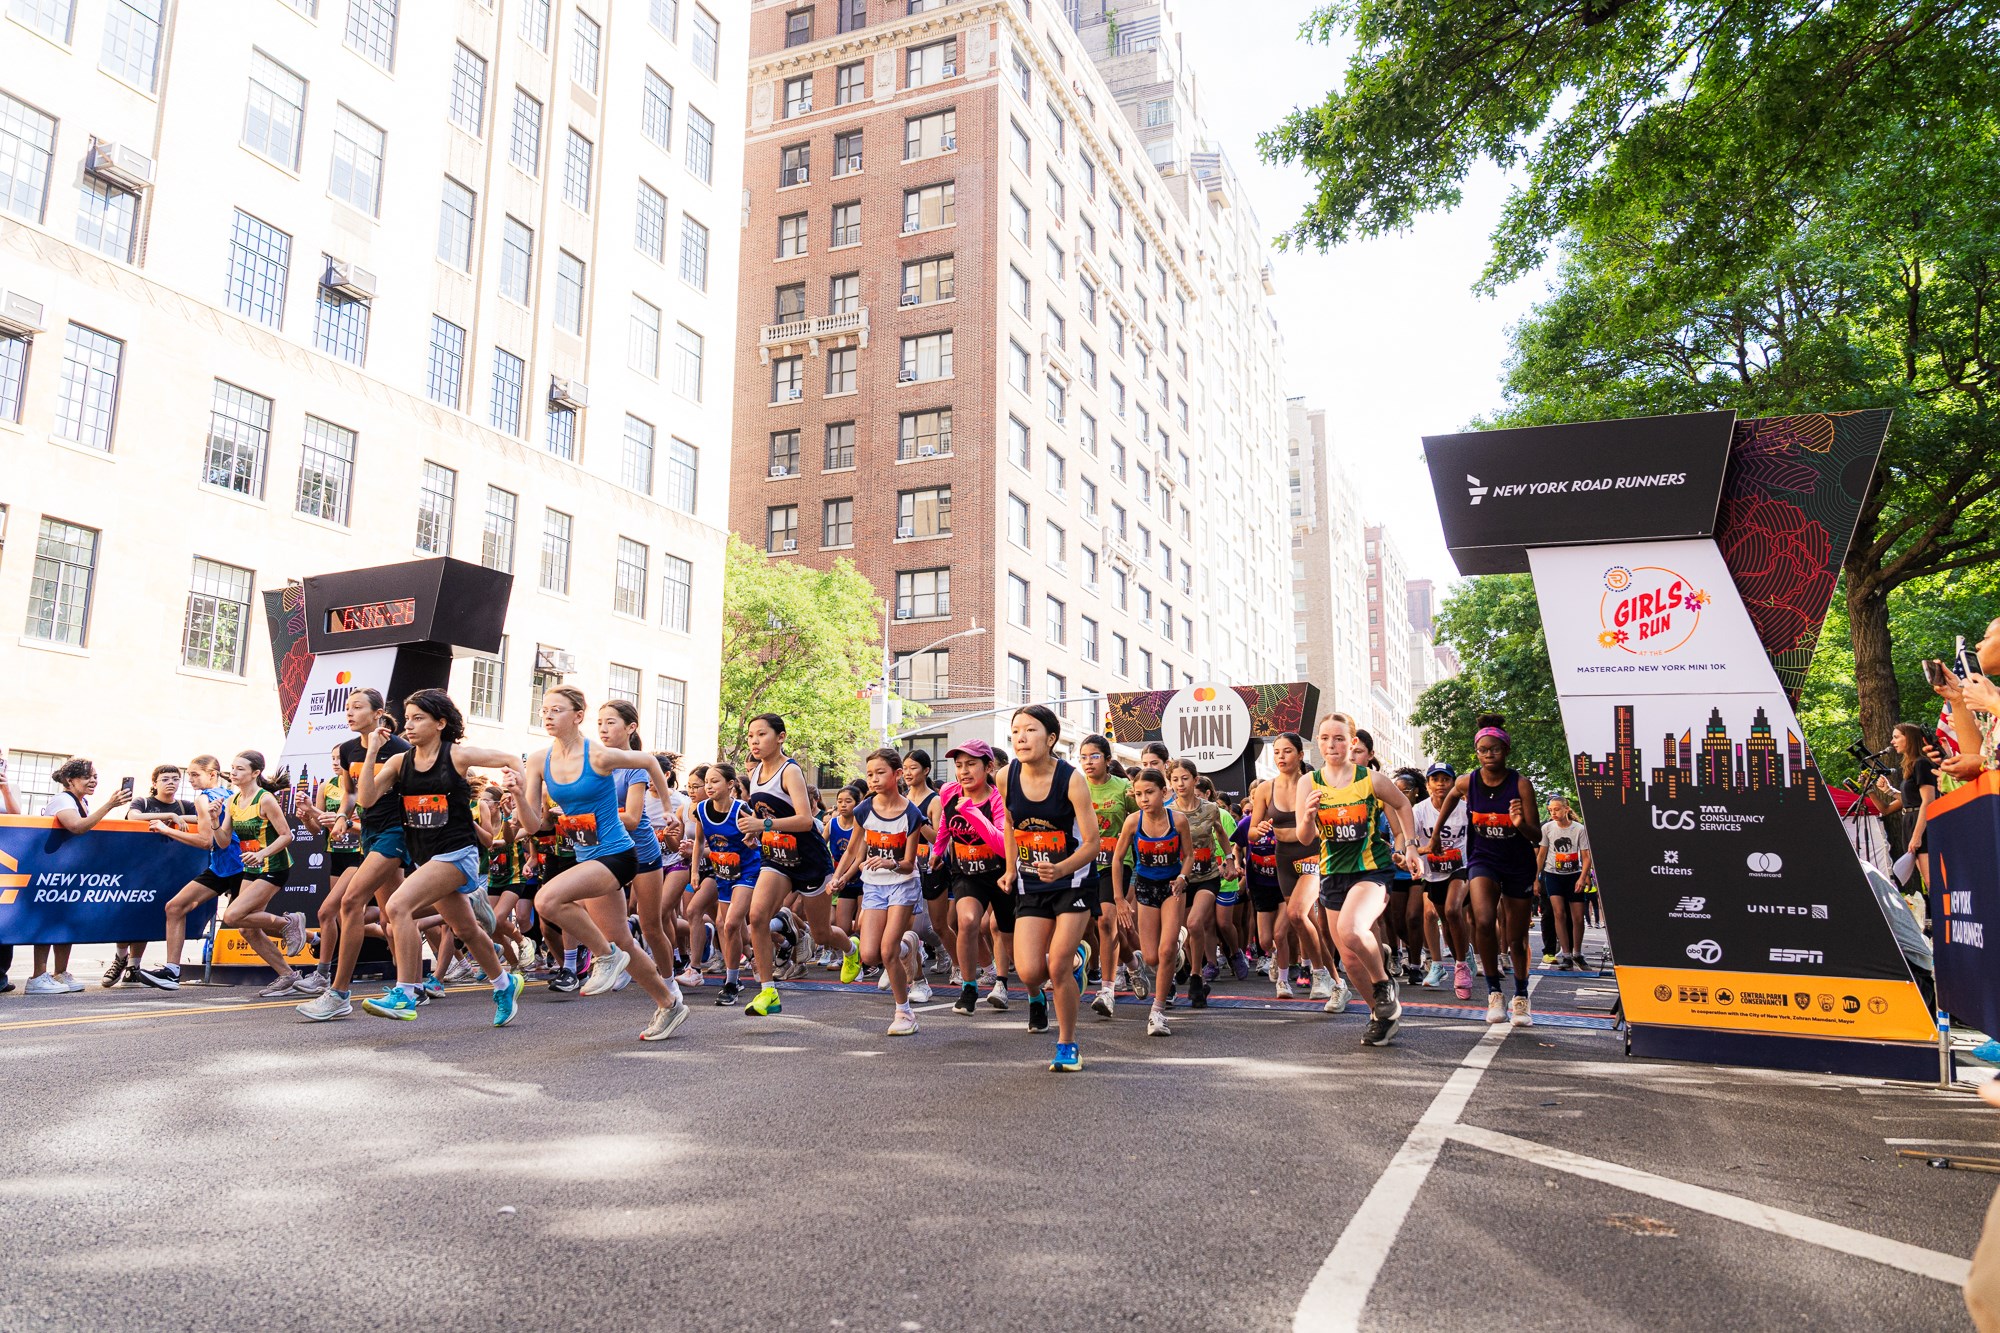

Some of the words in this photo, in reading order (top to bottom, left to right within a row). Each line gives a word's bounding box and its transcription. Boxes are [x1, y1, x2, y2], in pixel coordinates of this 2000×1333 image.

[1493, 484, 1527, 498] NEW
[1529, 481, 1569, 494] YORK
[1571, 478, 1612, 492] ROAD
[1615, 472, 1686, 489] RUNNERS
[1614, 580, 1682, 627] GIRLS
[1639, 613, 1670, 640] RUN
[1577, 665, 1635, 673] MASTERCARD
[310, 696, 325, 704] NEW
[325, 687, 357, 716] MIN
[1205, 704, 1231, 712] YORK
[1180, 714, 1232, 751] MINI
[1198, 752, 1215, 760] 10K
[417, 812, 432, 824] 117
[1651, 804, 1695, 830] tcs
[1700, 814, 1765, 823] CONSULTANCY
[1336, 825, 1356, 838] 906
[1486, 827, 1504, 836] 602
[1700, 823, 1741, 831] SERVICES
[576, 831, 586, 843] 42
[773, 848, 787, 859] 514
[1020, 847, 1028, 858] B
[1032, 850, 1050, 863] 516
[1152, 854, 1168, 864] 301
[968, 861, 985, 871] 276
[1260, 867, 1275, 875] 443
[1651, 866, 1693, 875] Citizens
[36, 873, 77, 886] NEW
[79, 874, 123, 886] YORK
[34, 889, 81, 903] ROAD
[83, 889, 157, 903] RUNNERS
[1951, 891, 1959, 913] NEW
[1747, 904, 1808, 915] UNITED
[1963, 921, 1984, 949] RUNNERS
[1769, 948, 1824, 963] ESPN
[1680, 991, 1708, 1002] DOT
[1740, 997, 1782, 1006] CONSERVANCY
[1842, 1000, 1858, 1010] MTA
